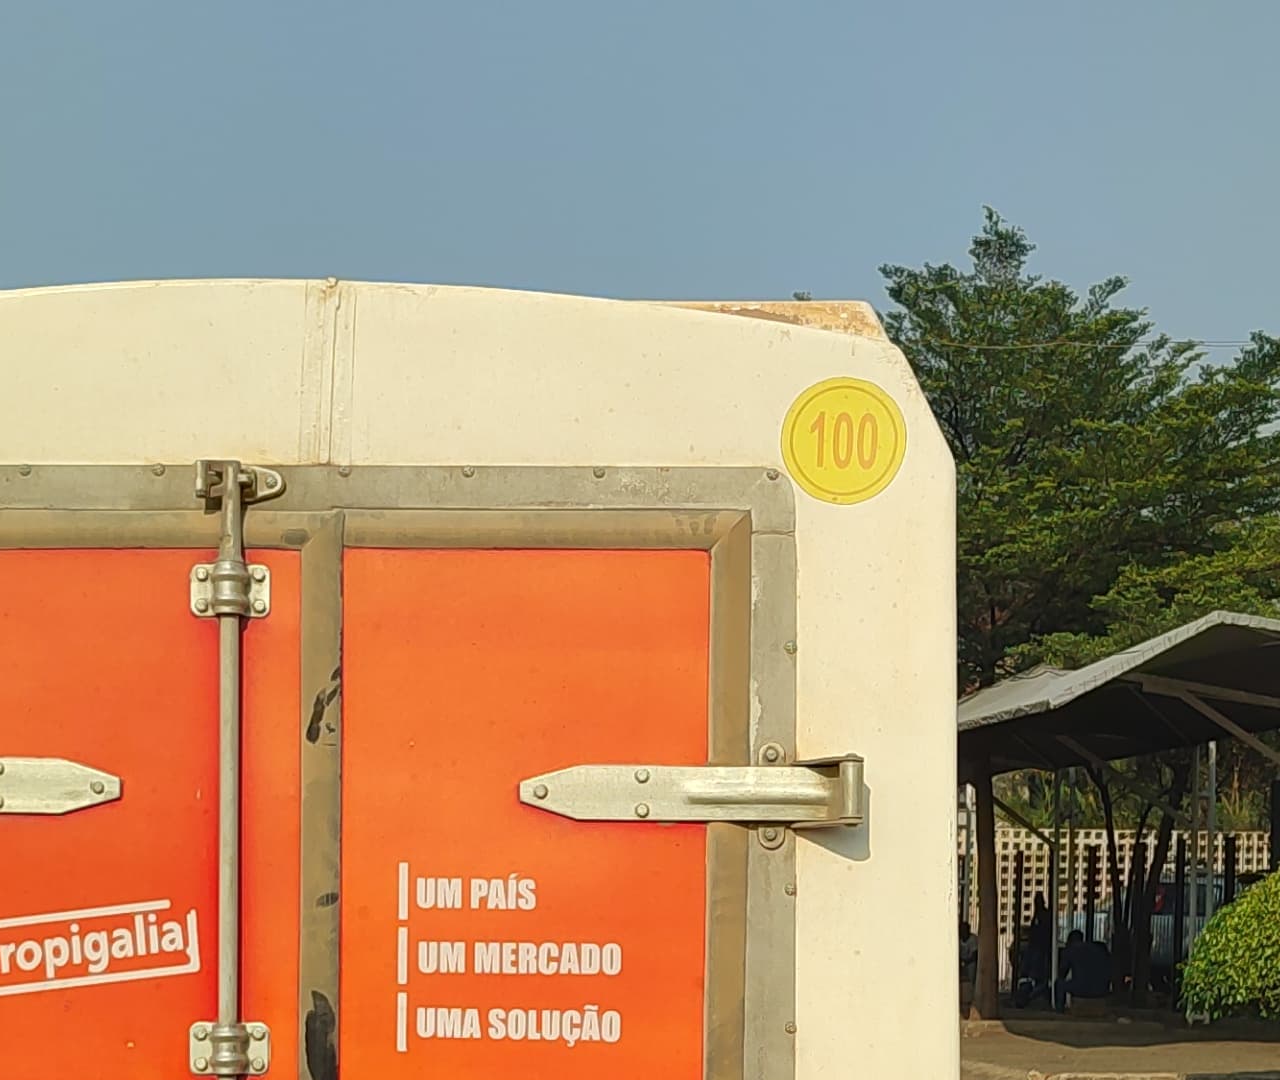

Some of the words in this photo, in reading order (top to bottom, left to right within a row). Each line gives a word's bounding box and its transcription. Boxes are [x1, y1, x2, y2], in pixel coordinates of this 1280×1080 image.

[809, 411, 878, 470] 100
[417, 878, 463, 909] UM
[470, 873, 537, 910] PAÍS
[418, 941, 466, 974] UM
[474, 942, 622, 975] MERCADO
[417, 1007, 482, 1039] UMA
[488, 1004, 622, 1047] SOLUÇÃO
